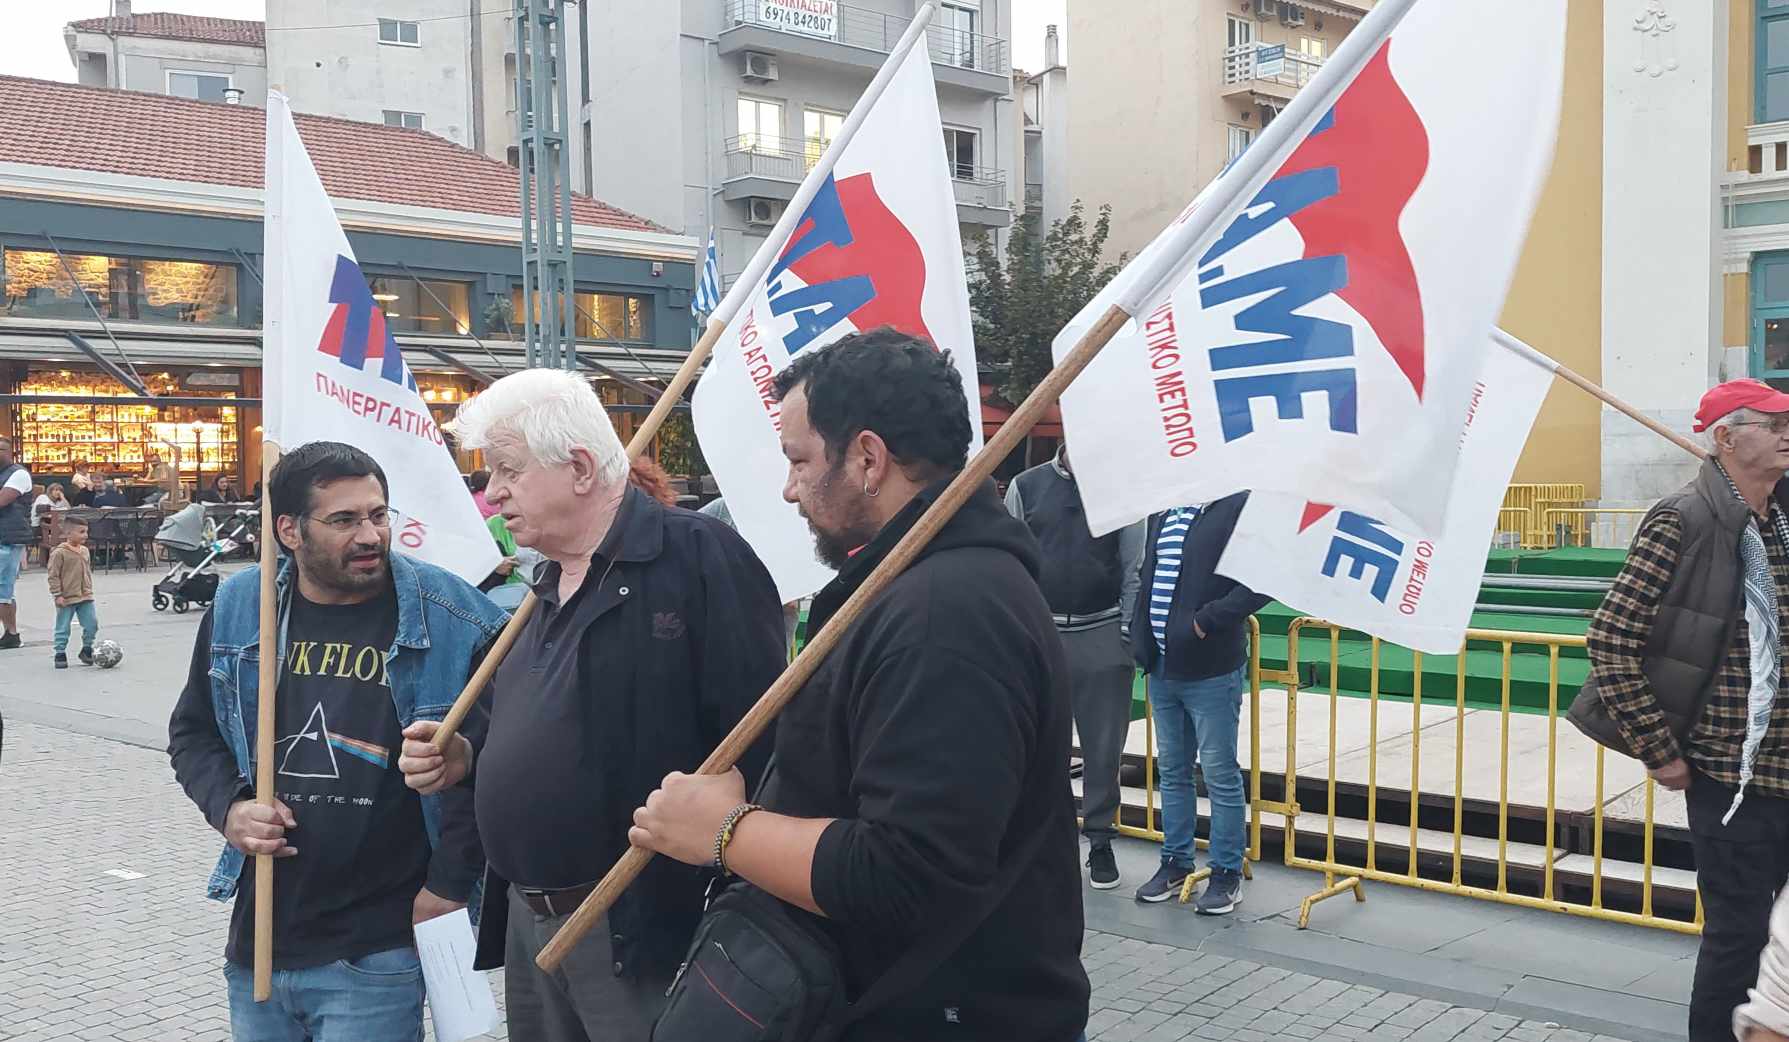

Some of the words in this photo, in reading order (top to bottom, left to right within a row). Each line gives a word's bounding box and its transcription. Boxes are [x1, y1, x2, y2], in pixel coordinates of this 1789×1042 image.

[1145, 300, 1180, 370] ΙΣΤΙΚΟ
[315, 372, 443, 446] ΠΑΝΕΡΓΑΤΙΚΟ
[1154, 370, 1198, 457] ΜΕΤΩΠΟ
